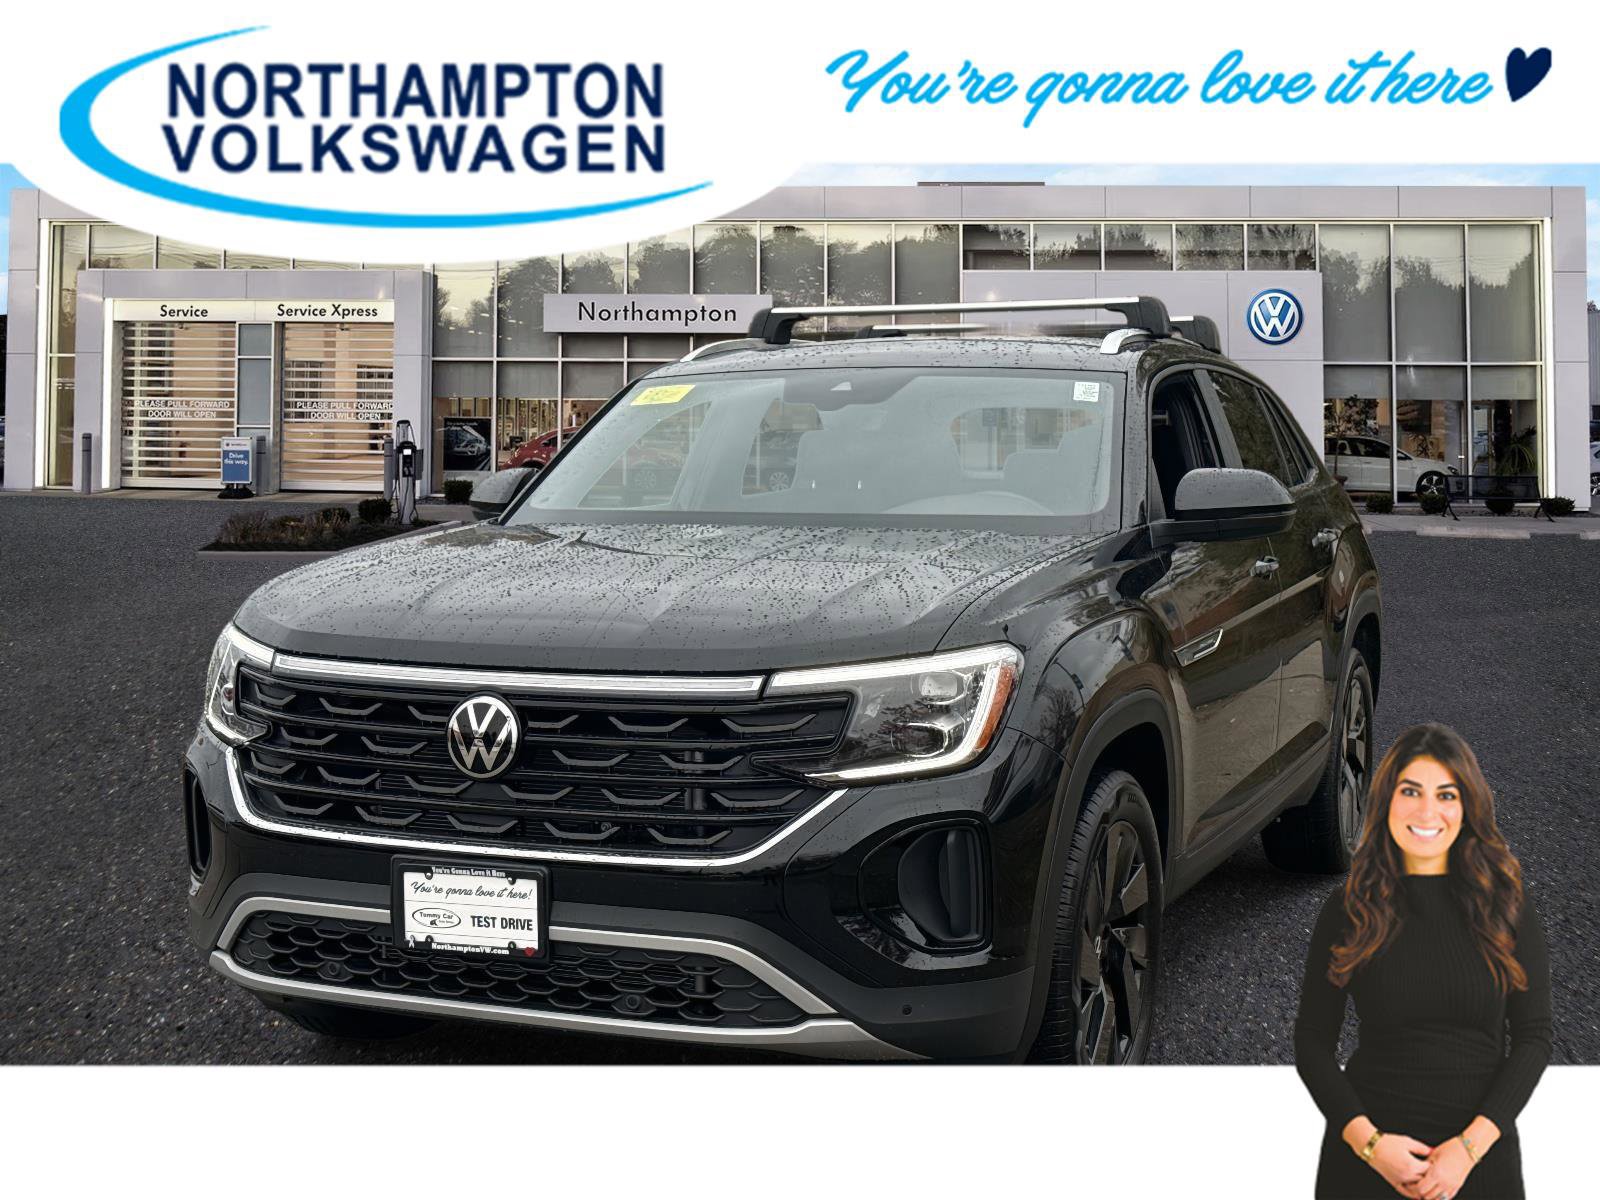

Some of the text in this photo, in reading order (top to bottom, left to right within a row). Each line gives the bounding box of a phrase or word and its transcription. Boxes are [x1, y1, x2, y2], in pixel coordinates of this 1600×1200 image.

[160, 304, 208, 318] Service
[276, 303, 378, 319] Service Xpress
[578, 301, 737, 327] Northampton
[134, 400, 230, 409] PLEASE PULL FORWARD
[296, 401, 394, 410] PLEASE PULL FORWARD
[193, 411, 217, 419] OPEN
[336, 412, 357, 420] WILL
[357, 412, 381, 420] OPEN
[410, 881, 533, 900] You're gonna love it here!
[470, 915, 534, 932] TEST DRIVE
[431, 942, 510, 955] NorthamptonVW.com
